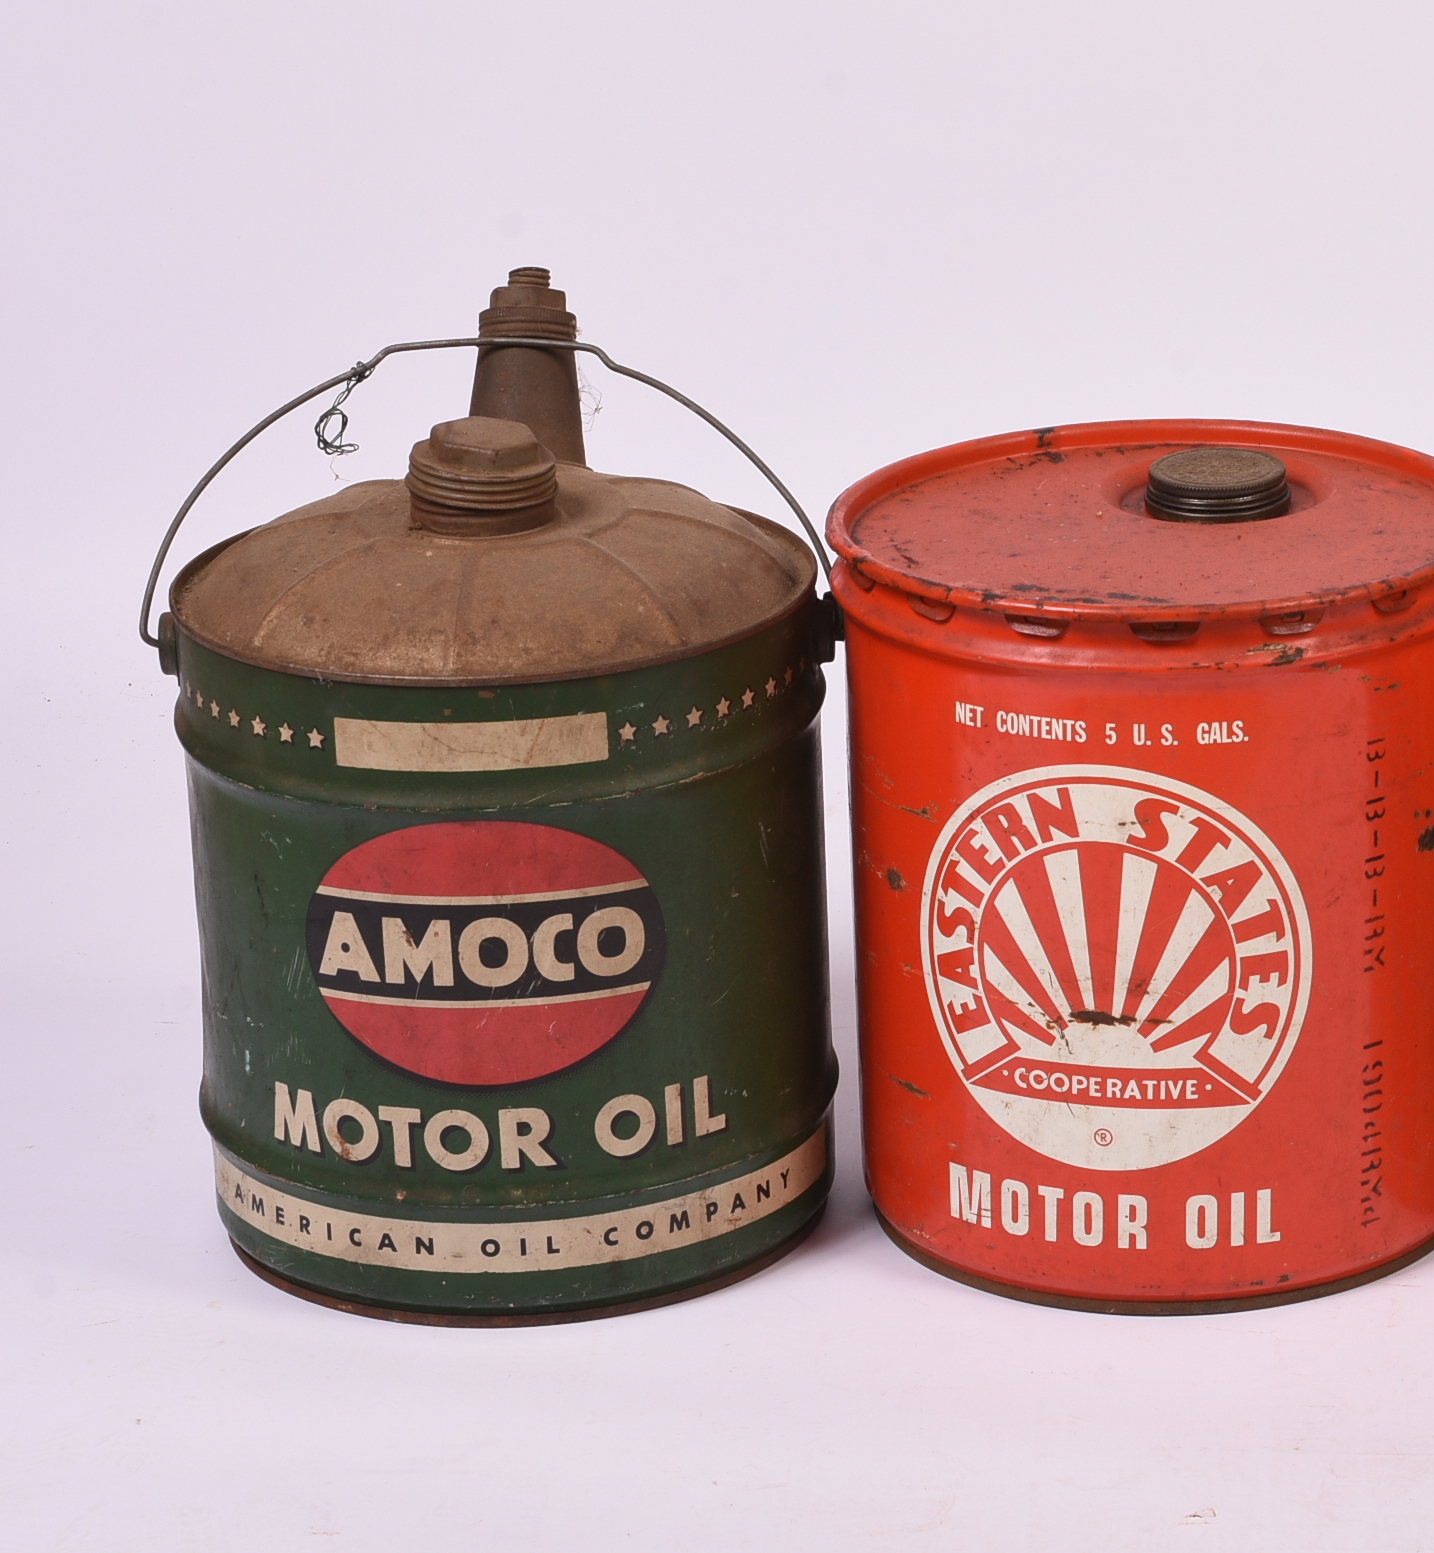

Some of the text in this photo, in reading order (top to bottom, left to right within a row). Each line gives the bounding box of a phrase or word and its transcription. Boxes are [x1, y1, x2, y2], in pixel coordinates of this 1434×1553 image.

[954, 700, 984, 729] NET
[995, 710, 1087, 743] CONTENTS
[1104, 722, 1118, 745] 5
[1196, 720, 1249, 745] GALS.
[318, 906, 646, 988] AMOCO
[936, 786, 1290, 1040] EASTERN STATES
[273, 1074, 727, 1171] MOTOR OIL
[1013, 1067, 1199, 1100] COOPERATIVE
[233, 1170, 792, 1259] AMERICAN OIL COMPANY
[948, 1161, 1281, 1250] MOTOR OIL
